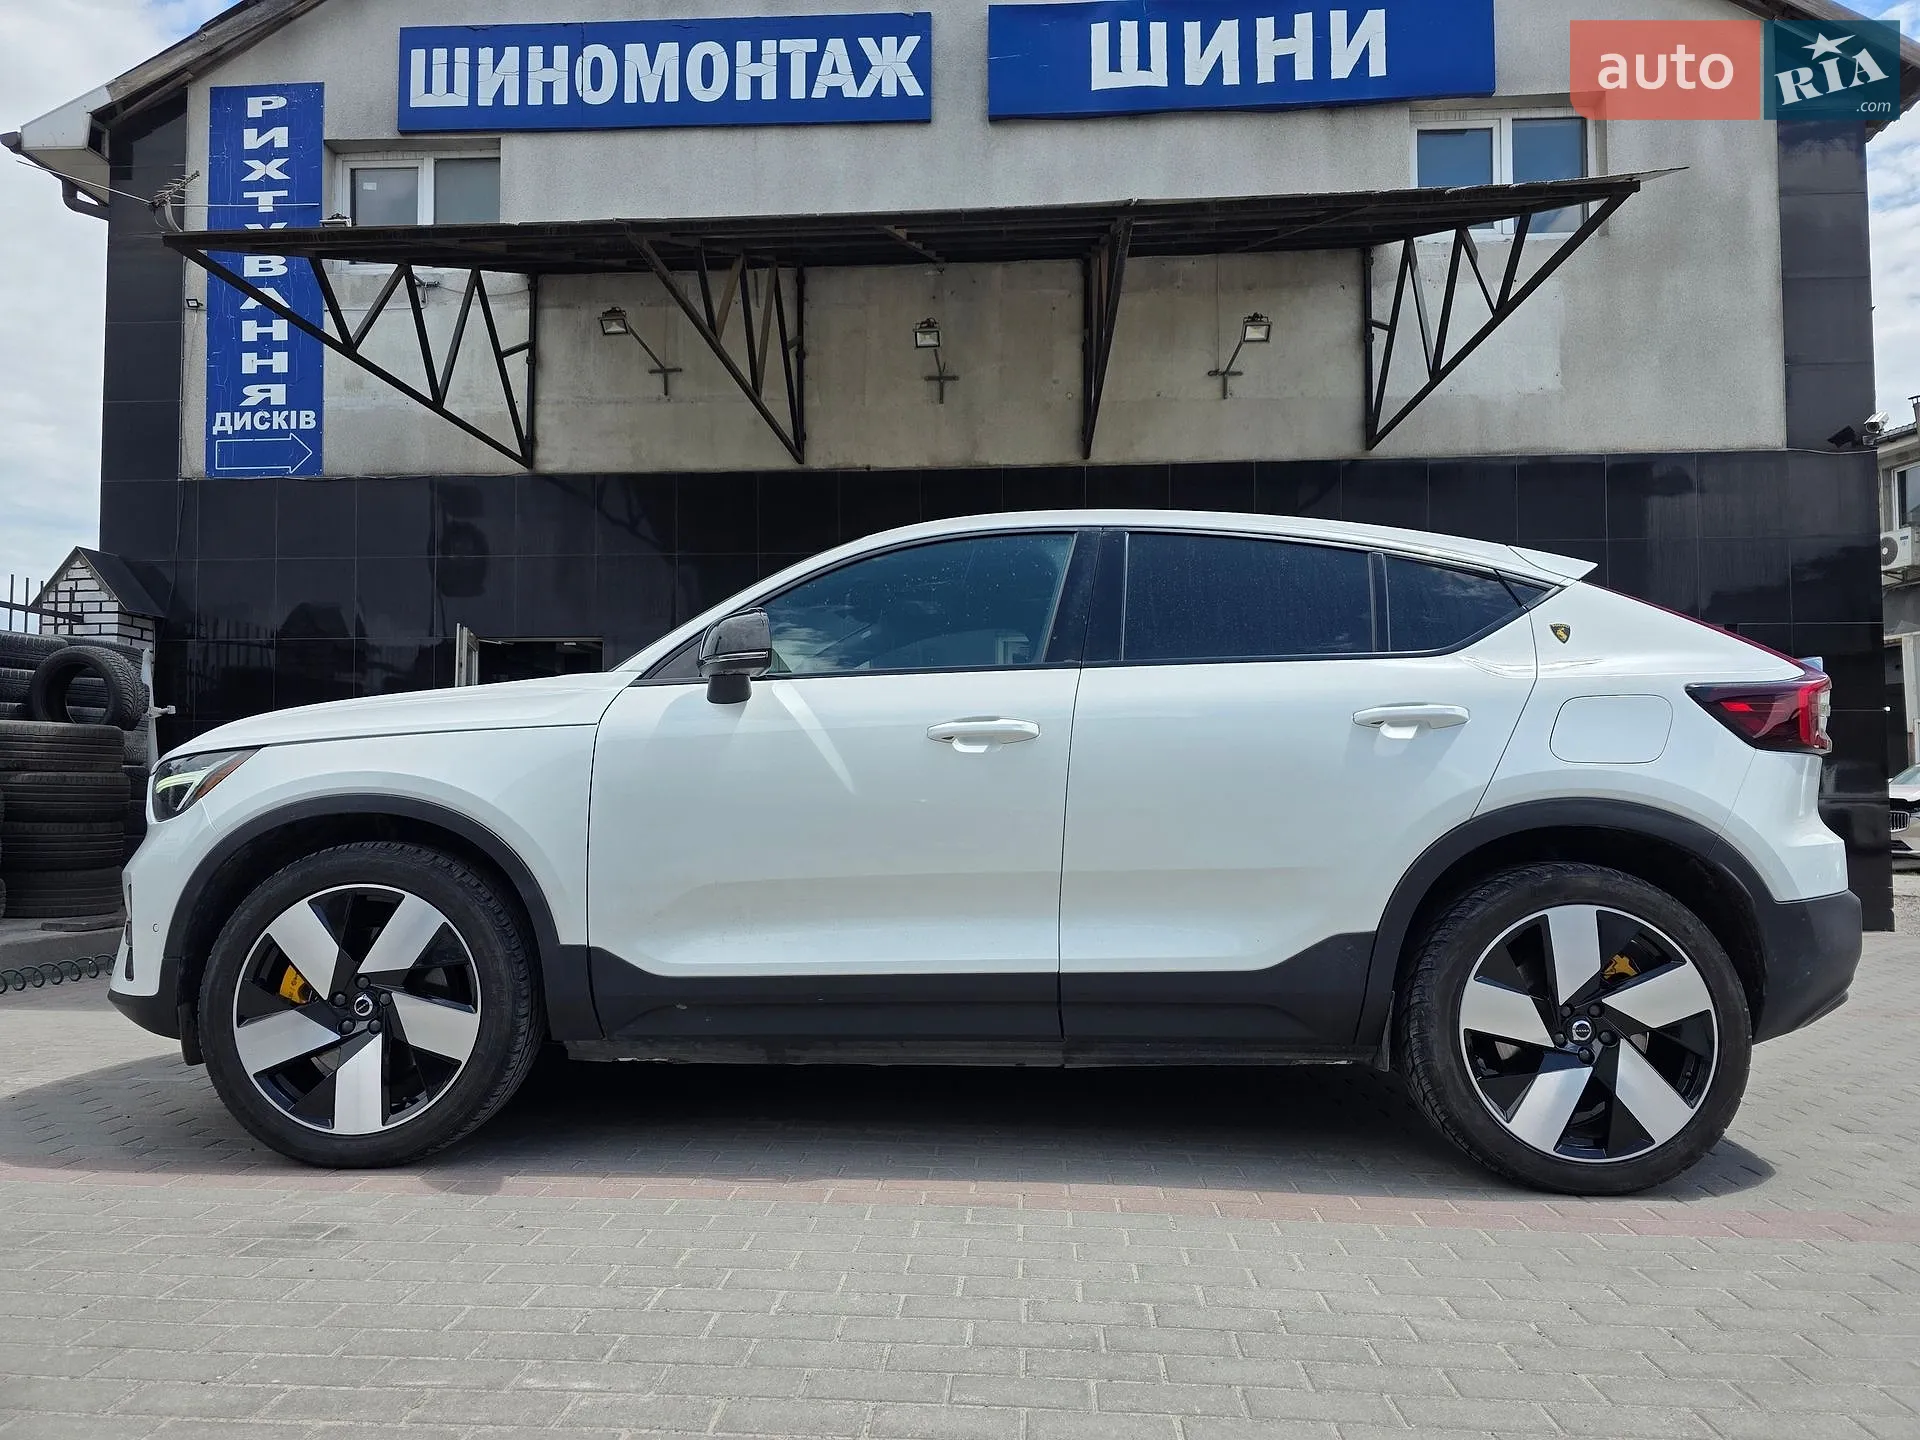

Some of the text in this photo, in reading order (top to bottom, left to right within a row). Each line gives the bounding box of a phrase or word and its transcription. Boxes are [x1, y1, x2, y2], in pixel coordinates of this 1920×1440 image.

[409, 36, 924, 107] ШИНОМОНТАЖ
[1090, 9, 1387, 91] ШИНИ
[212, 410, 317, 435] ДИСКІВ
